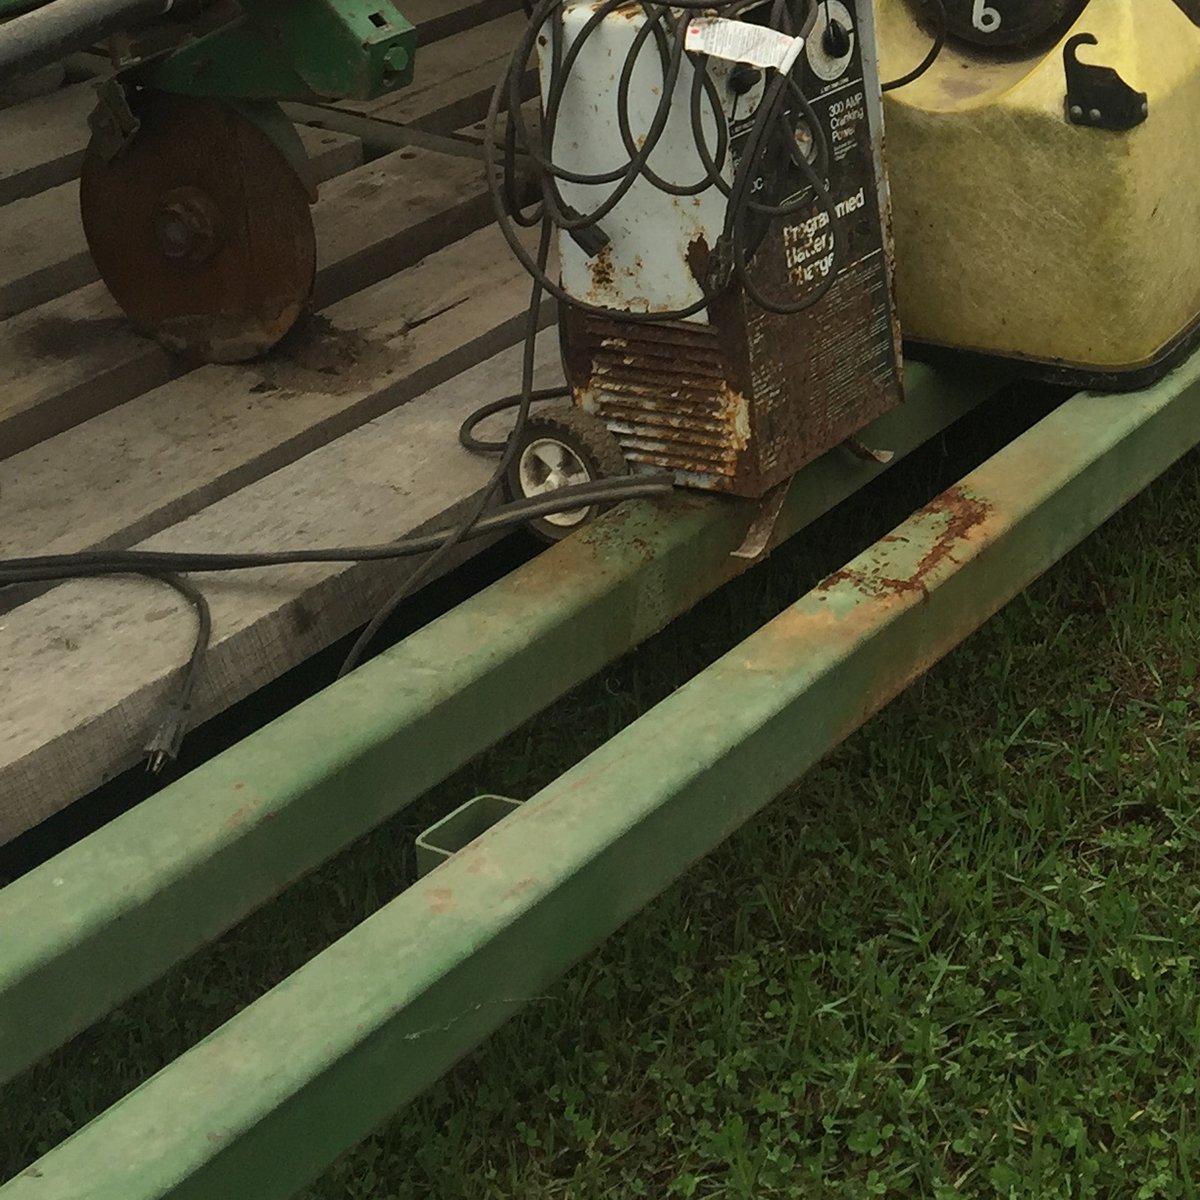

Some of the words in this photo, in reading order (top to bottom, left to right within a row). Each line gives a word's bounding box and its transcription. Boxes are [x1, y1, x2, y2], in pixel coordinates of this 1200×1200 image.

[828, 100, 844, 118] 300
[845, 91, 863, 110] AMP
[830, 106, 865, 130] Cranking
[783, 186, 865, 247] Programed
[787, 251, 835, 286] Charge
